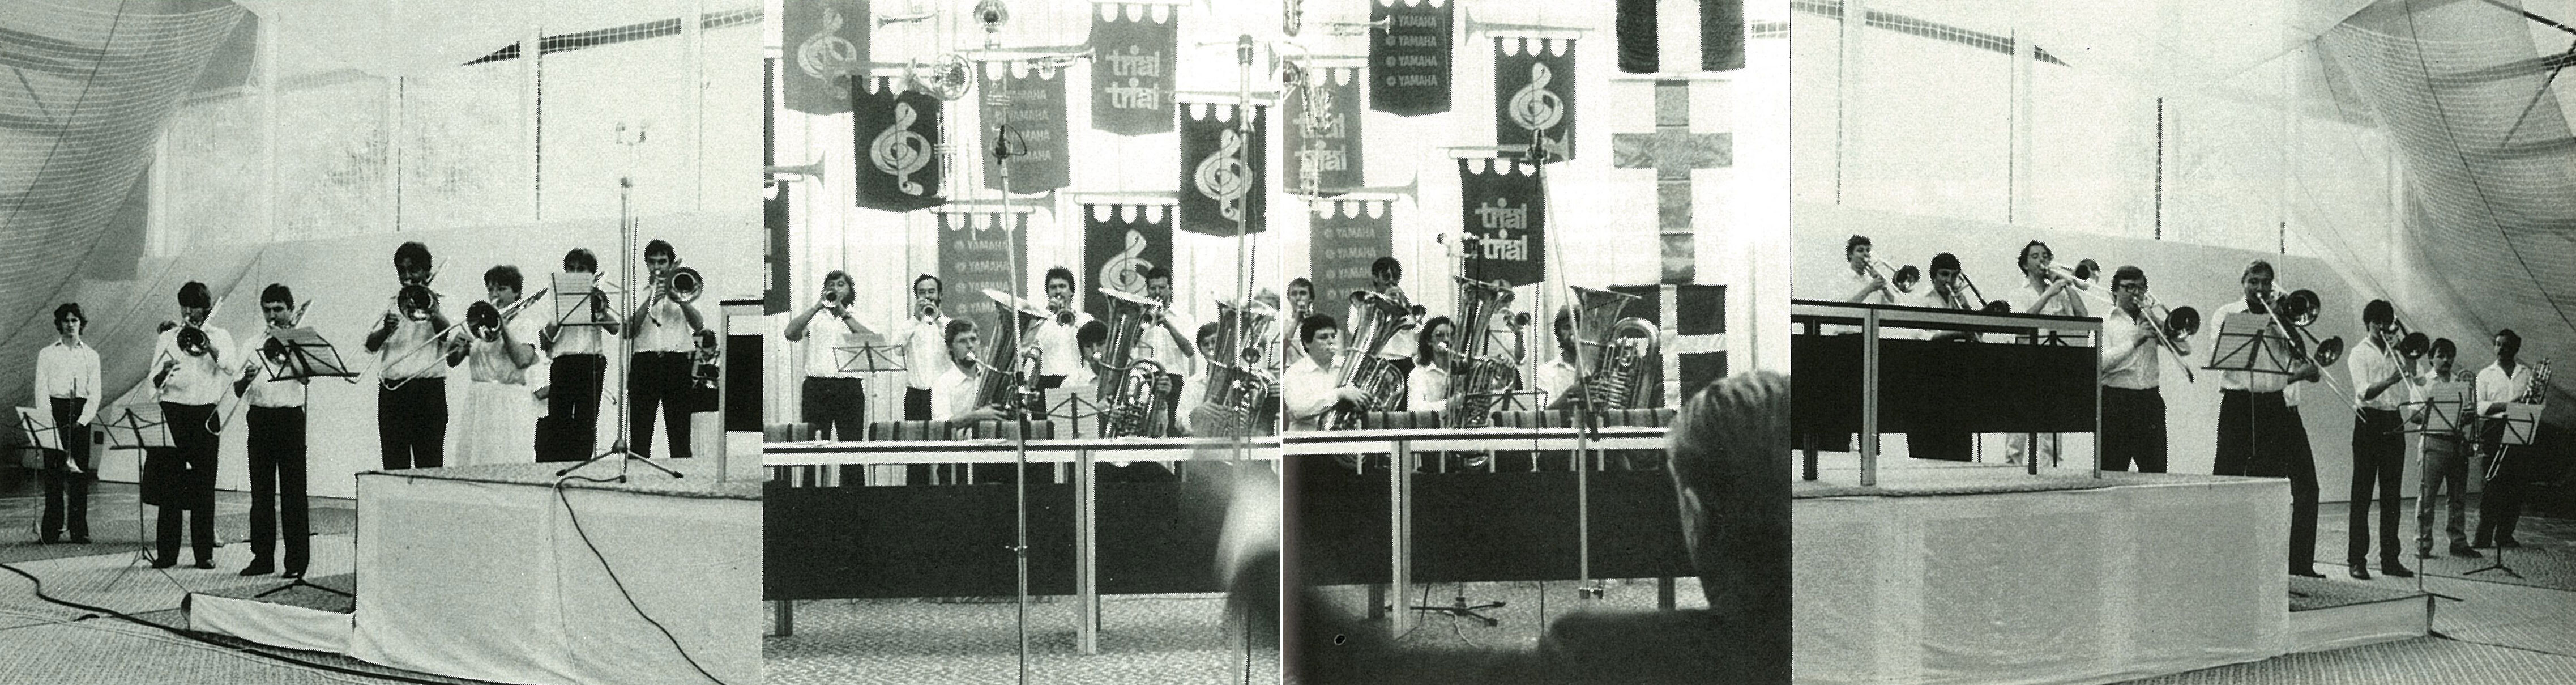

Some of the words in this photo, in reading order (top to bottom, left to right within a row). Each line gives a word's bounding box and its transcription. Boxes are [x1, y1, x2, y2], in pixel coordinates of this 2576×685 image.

[1398, 15, 1437, 27] YAMAHA
[1399, 35, 1437, 46] YAMAHA
[1105, 45, 1160, 77] trial
[1399, 55, 1438, 67] YAMAHA
[1398, 75, 1438, 86] YAMAHA
[1105, 77, 1160, 110] trial
[1475, 197, 1527, 229] trial
[1336, 227, 1375, 238] YAMAHA
[967, 240, 1008, 250] YAMAHA
[1479, 228, 1528, 261] trial
[1338, 247, 1377, 258] YAMAHA
[969, 261, 1010, 273] YAMAHA
[1339, 267, 1372, 279] YAMAH
